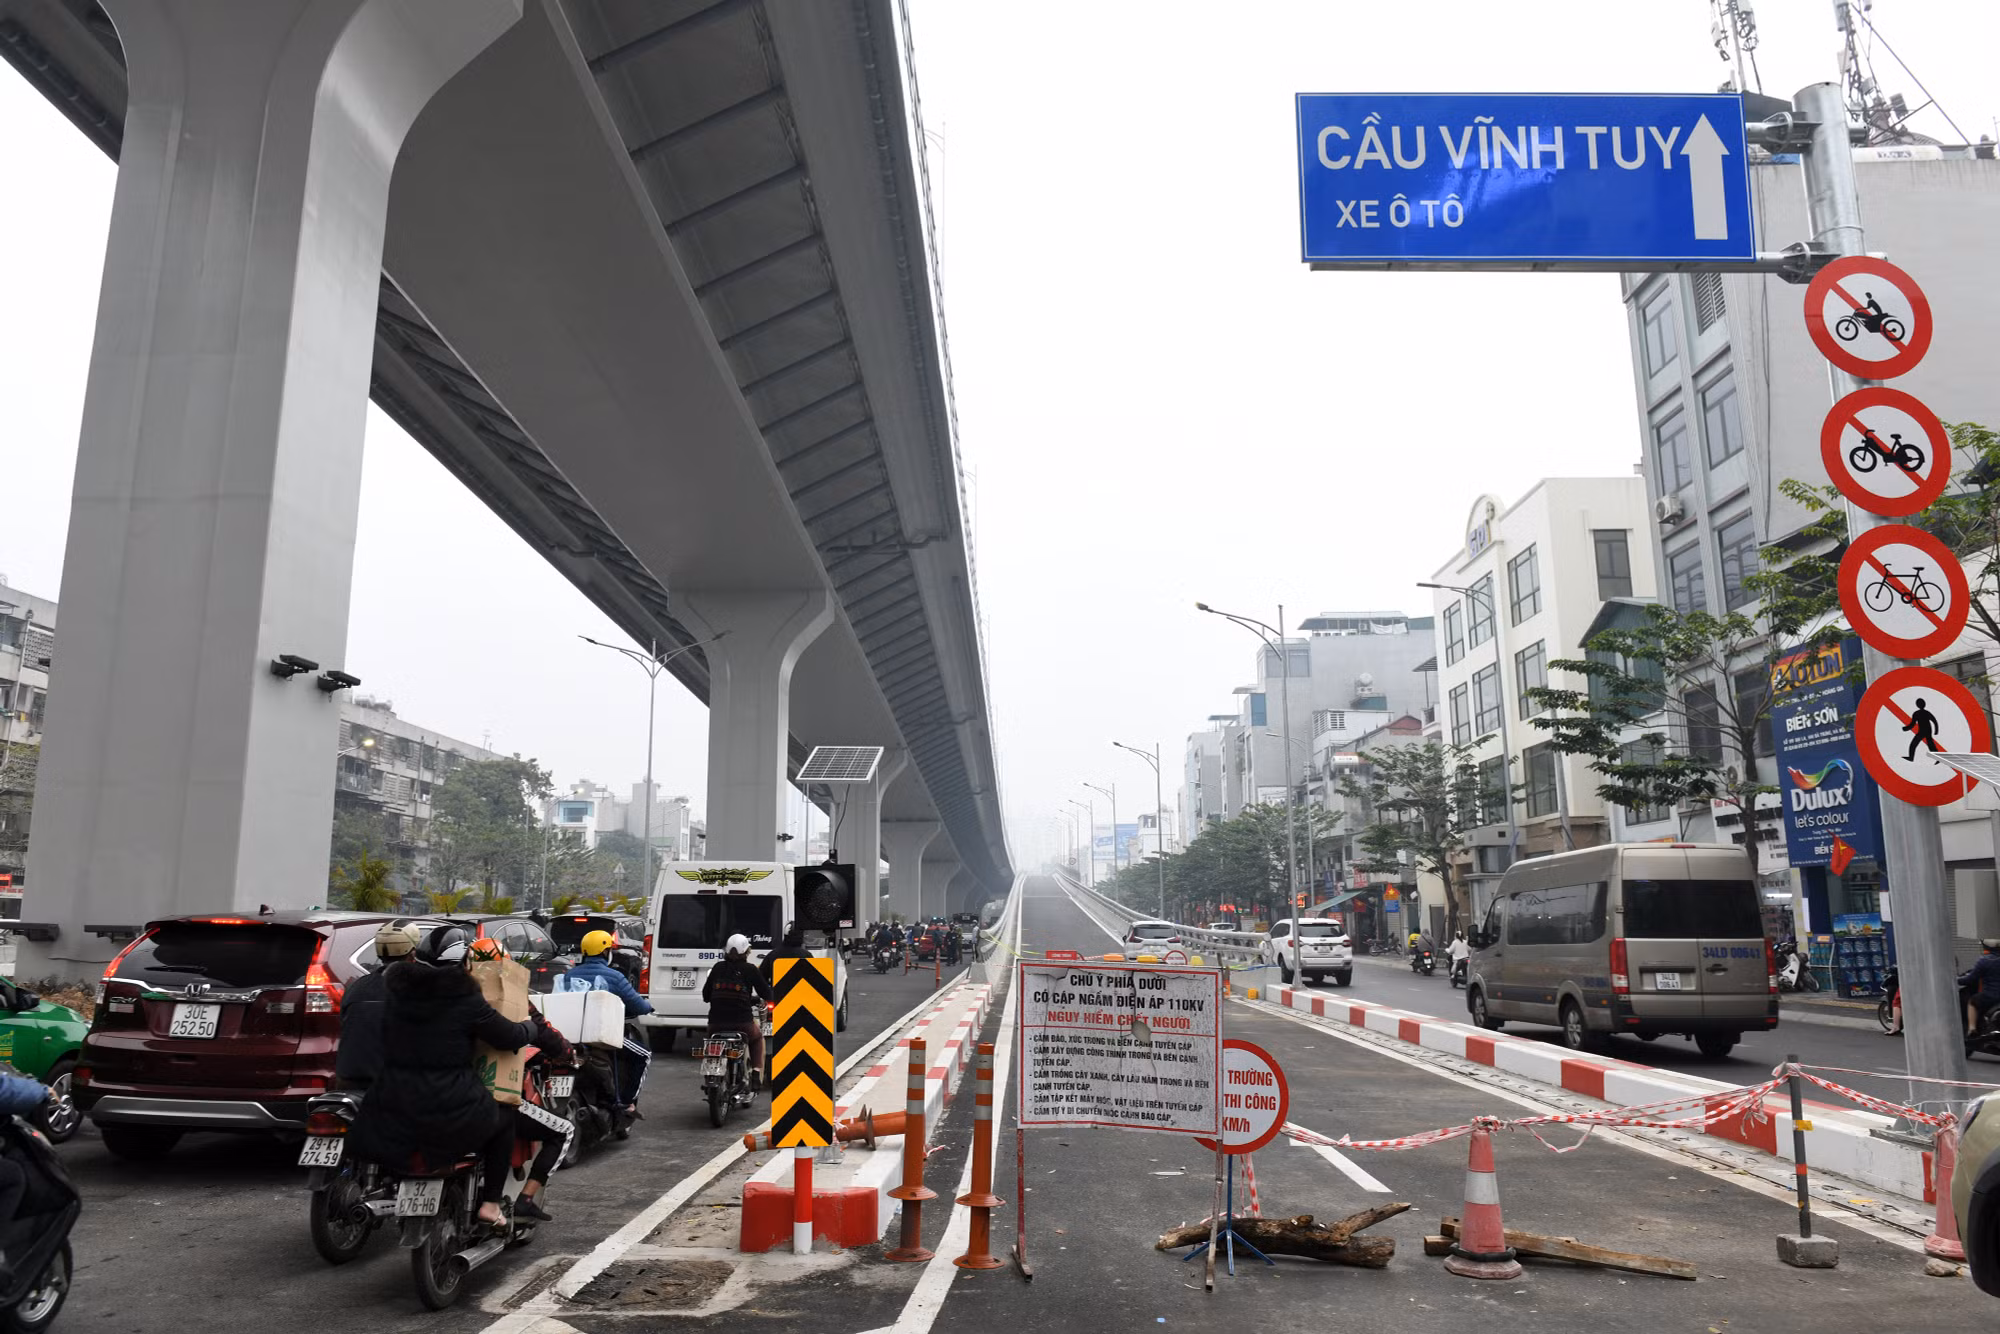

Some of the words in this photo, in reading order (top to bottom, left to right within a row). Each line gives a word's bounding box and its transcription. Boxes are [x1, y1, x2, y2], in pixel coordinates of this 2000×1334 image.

[1317, 111, 1427, 170] CẦU
[1439, 116, 1565, 170] VĨNH
[1575, 126, 1681, 170] TUY
[1335, 199, 1380, 229] XE
[1389, 193, 1411, 229] Ô
[1420, 194, 1464, 229] TÔ
[1813, 705, 1839, 727] SƠN
[1790, 786, 1848, 812] Dulux
[1794, 813, 1815, 829] let's
[1816, 811, 1850, 826] colour
[1070, 972, 1093, 986] CHÚ
[1096, 973, 1103, 987] Ý
[1107, 975, 1134, 989] PHÍA
[1139, 975, 1166, 990] DƯỚI
[1034, 988, 1048, 1003] CÓ
[1052, 990, 1075, 1005] CÁP
[1117, 993, 1145, 1010] ĐIỆN
[1148, 995, 1165, 1009] ÁP
[1168, 998, 1204, 1012] 110KV
[184, 1005, 207, 1020] 30E
[1048, 1011, 1080, 1022] NGUY
[1152, 1015, 1191, 1029] NGƯỜI
[171, 1020, 214, 1037] 252.50
[1227, 1067, 1273, 1086] TRƯỜNG
[1223, 1093, 1241, 1108] THI
[1245, 1092, 1276, 1110] CÔNG
[300, 1151, 339, 1165] 274.59
[413, 1182, 427, 1197] 32
